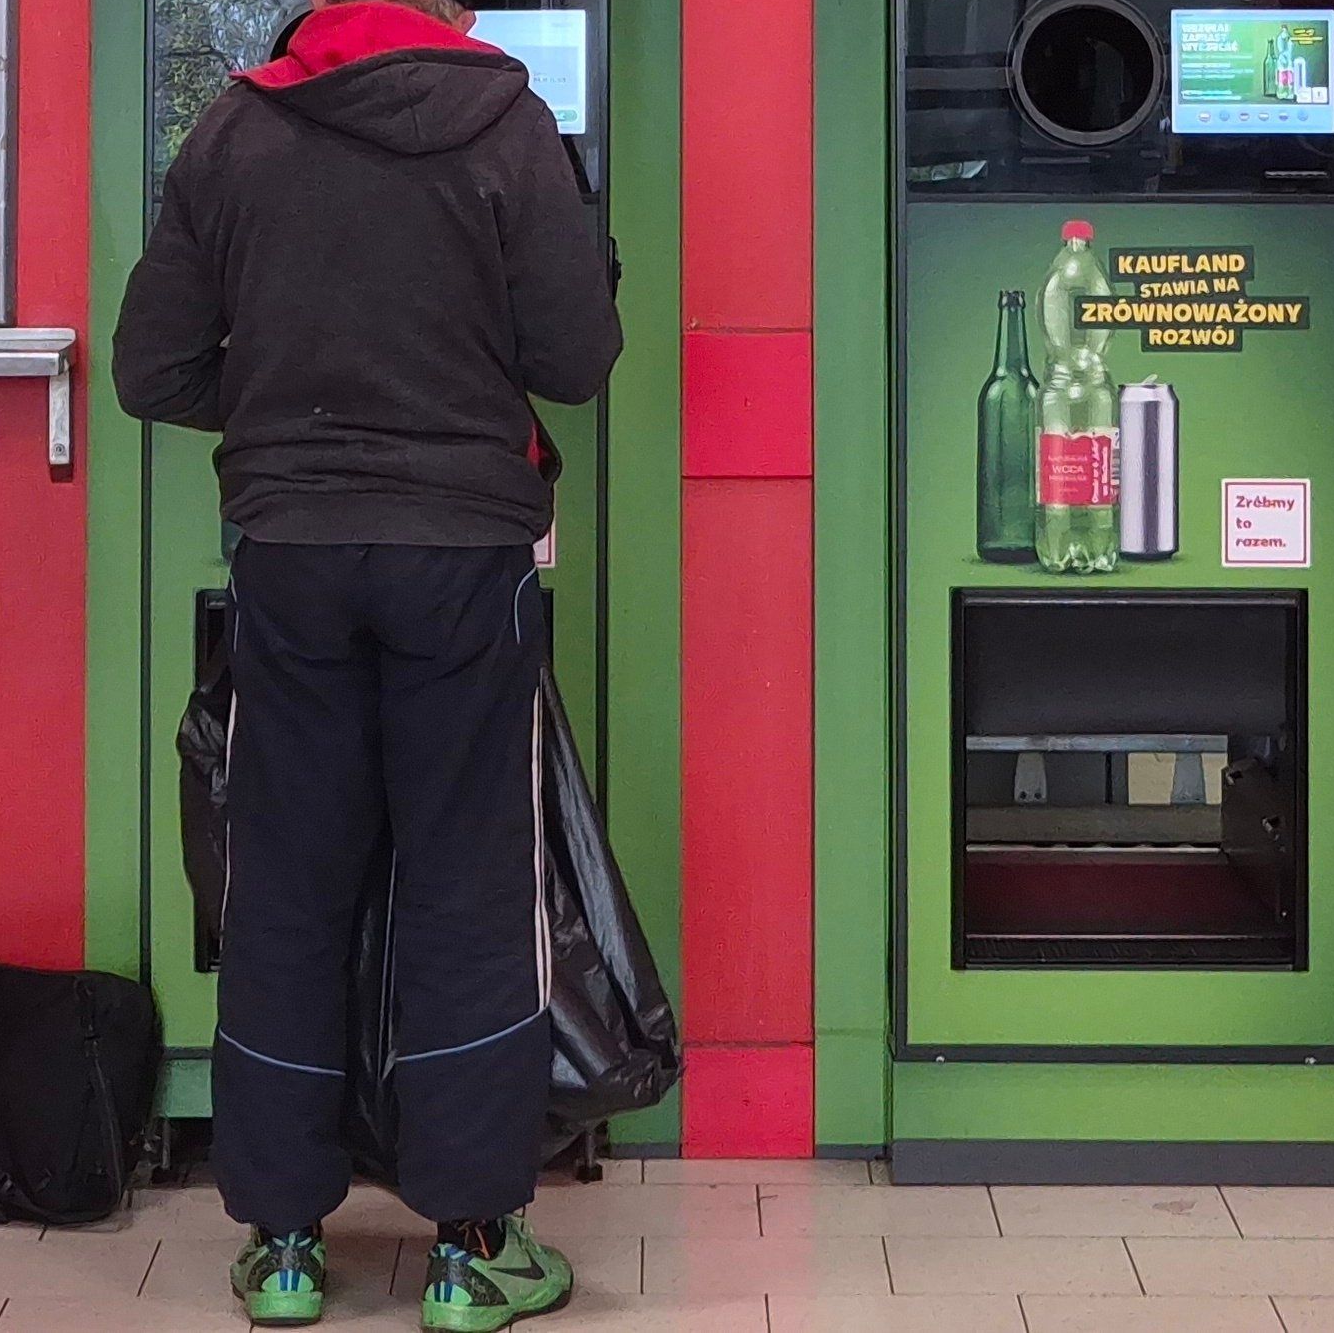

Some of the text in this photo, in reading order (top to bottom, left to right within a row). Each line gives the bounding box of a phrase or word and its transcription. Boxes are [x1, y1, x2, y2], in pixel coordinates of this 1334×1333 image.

[1118, 255, 1245, 273] KAUFLAND
[1140, 278, 1239, 298] STAWIA NA
[1082, 299, 1302, 323] ZRÓWNOWAŻONY
[1148, 327, 1234, 345] ROZWÓJ
[1236, 495, 1294, 510] Zróbmy
[1236, 517, 1251, 529] to
[1236, 537, 1286, 548] razem.
